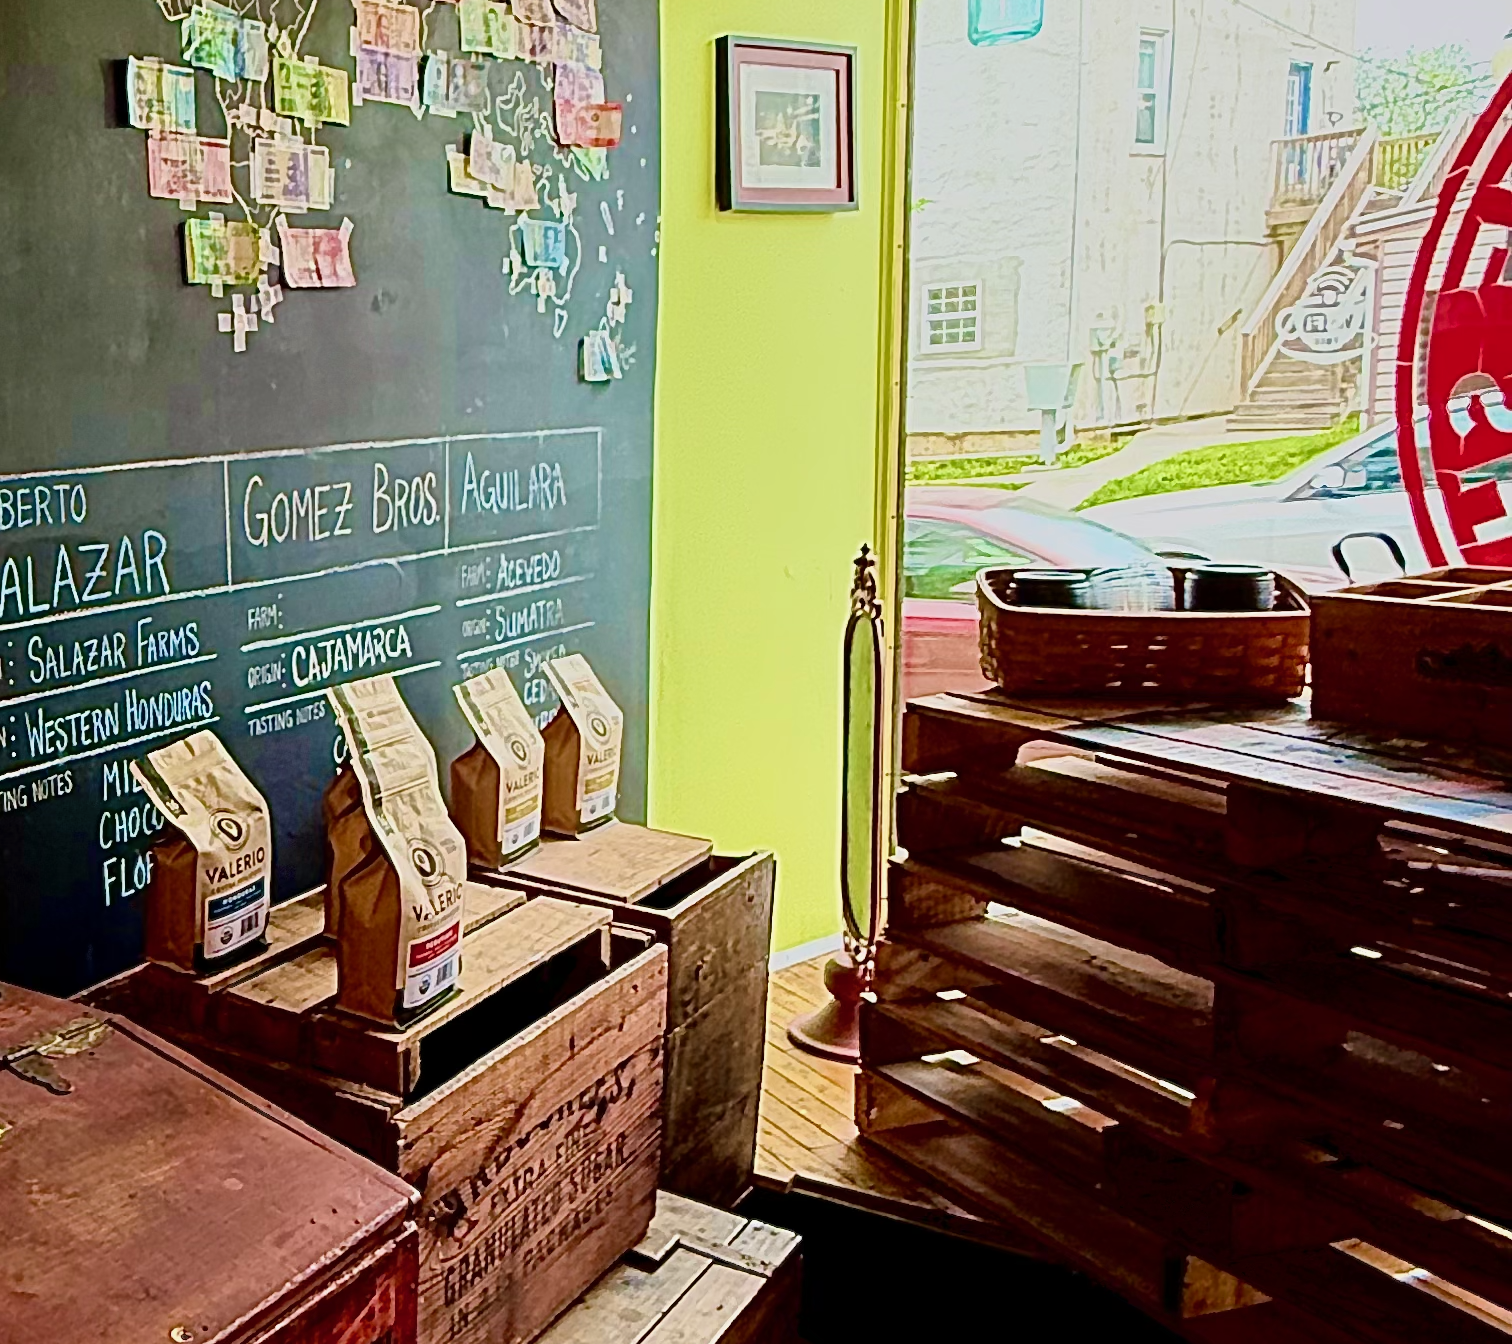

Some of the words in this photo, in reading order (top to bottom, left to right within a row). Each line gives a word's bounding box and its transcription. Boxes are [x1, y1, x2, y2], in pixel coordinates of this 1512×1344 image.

[243, 475, 354, 548] GOMEZ
[373, 462, 441, 534] BROS.
[461, 451, 567, 515] AGUILARA
[495, 549, 561, 591] ACEVEDO
[495, 597, 565, 642] SUMATRA
[27, 631, 126, 684] SALAZAR
[137, 617, 200, 666] FARMS
[291, 624, 413, 689] CAJAMARCA
[24, 707, 119, 758] WESTERN
[124, 680, 214, 733] HONDURAS
[32, 769, 74, 803] NOTES
[205, 847, 266, 885] VALERIO
[412, 882, 464, 922] VLERIO
